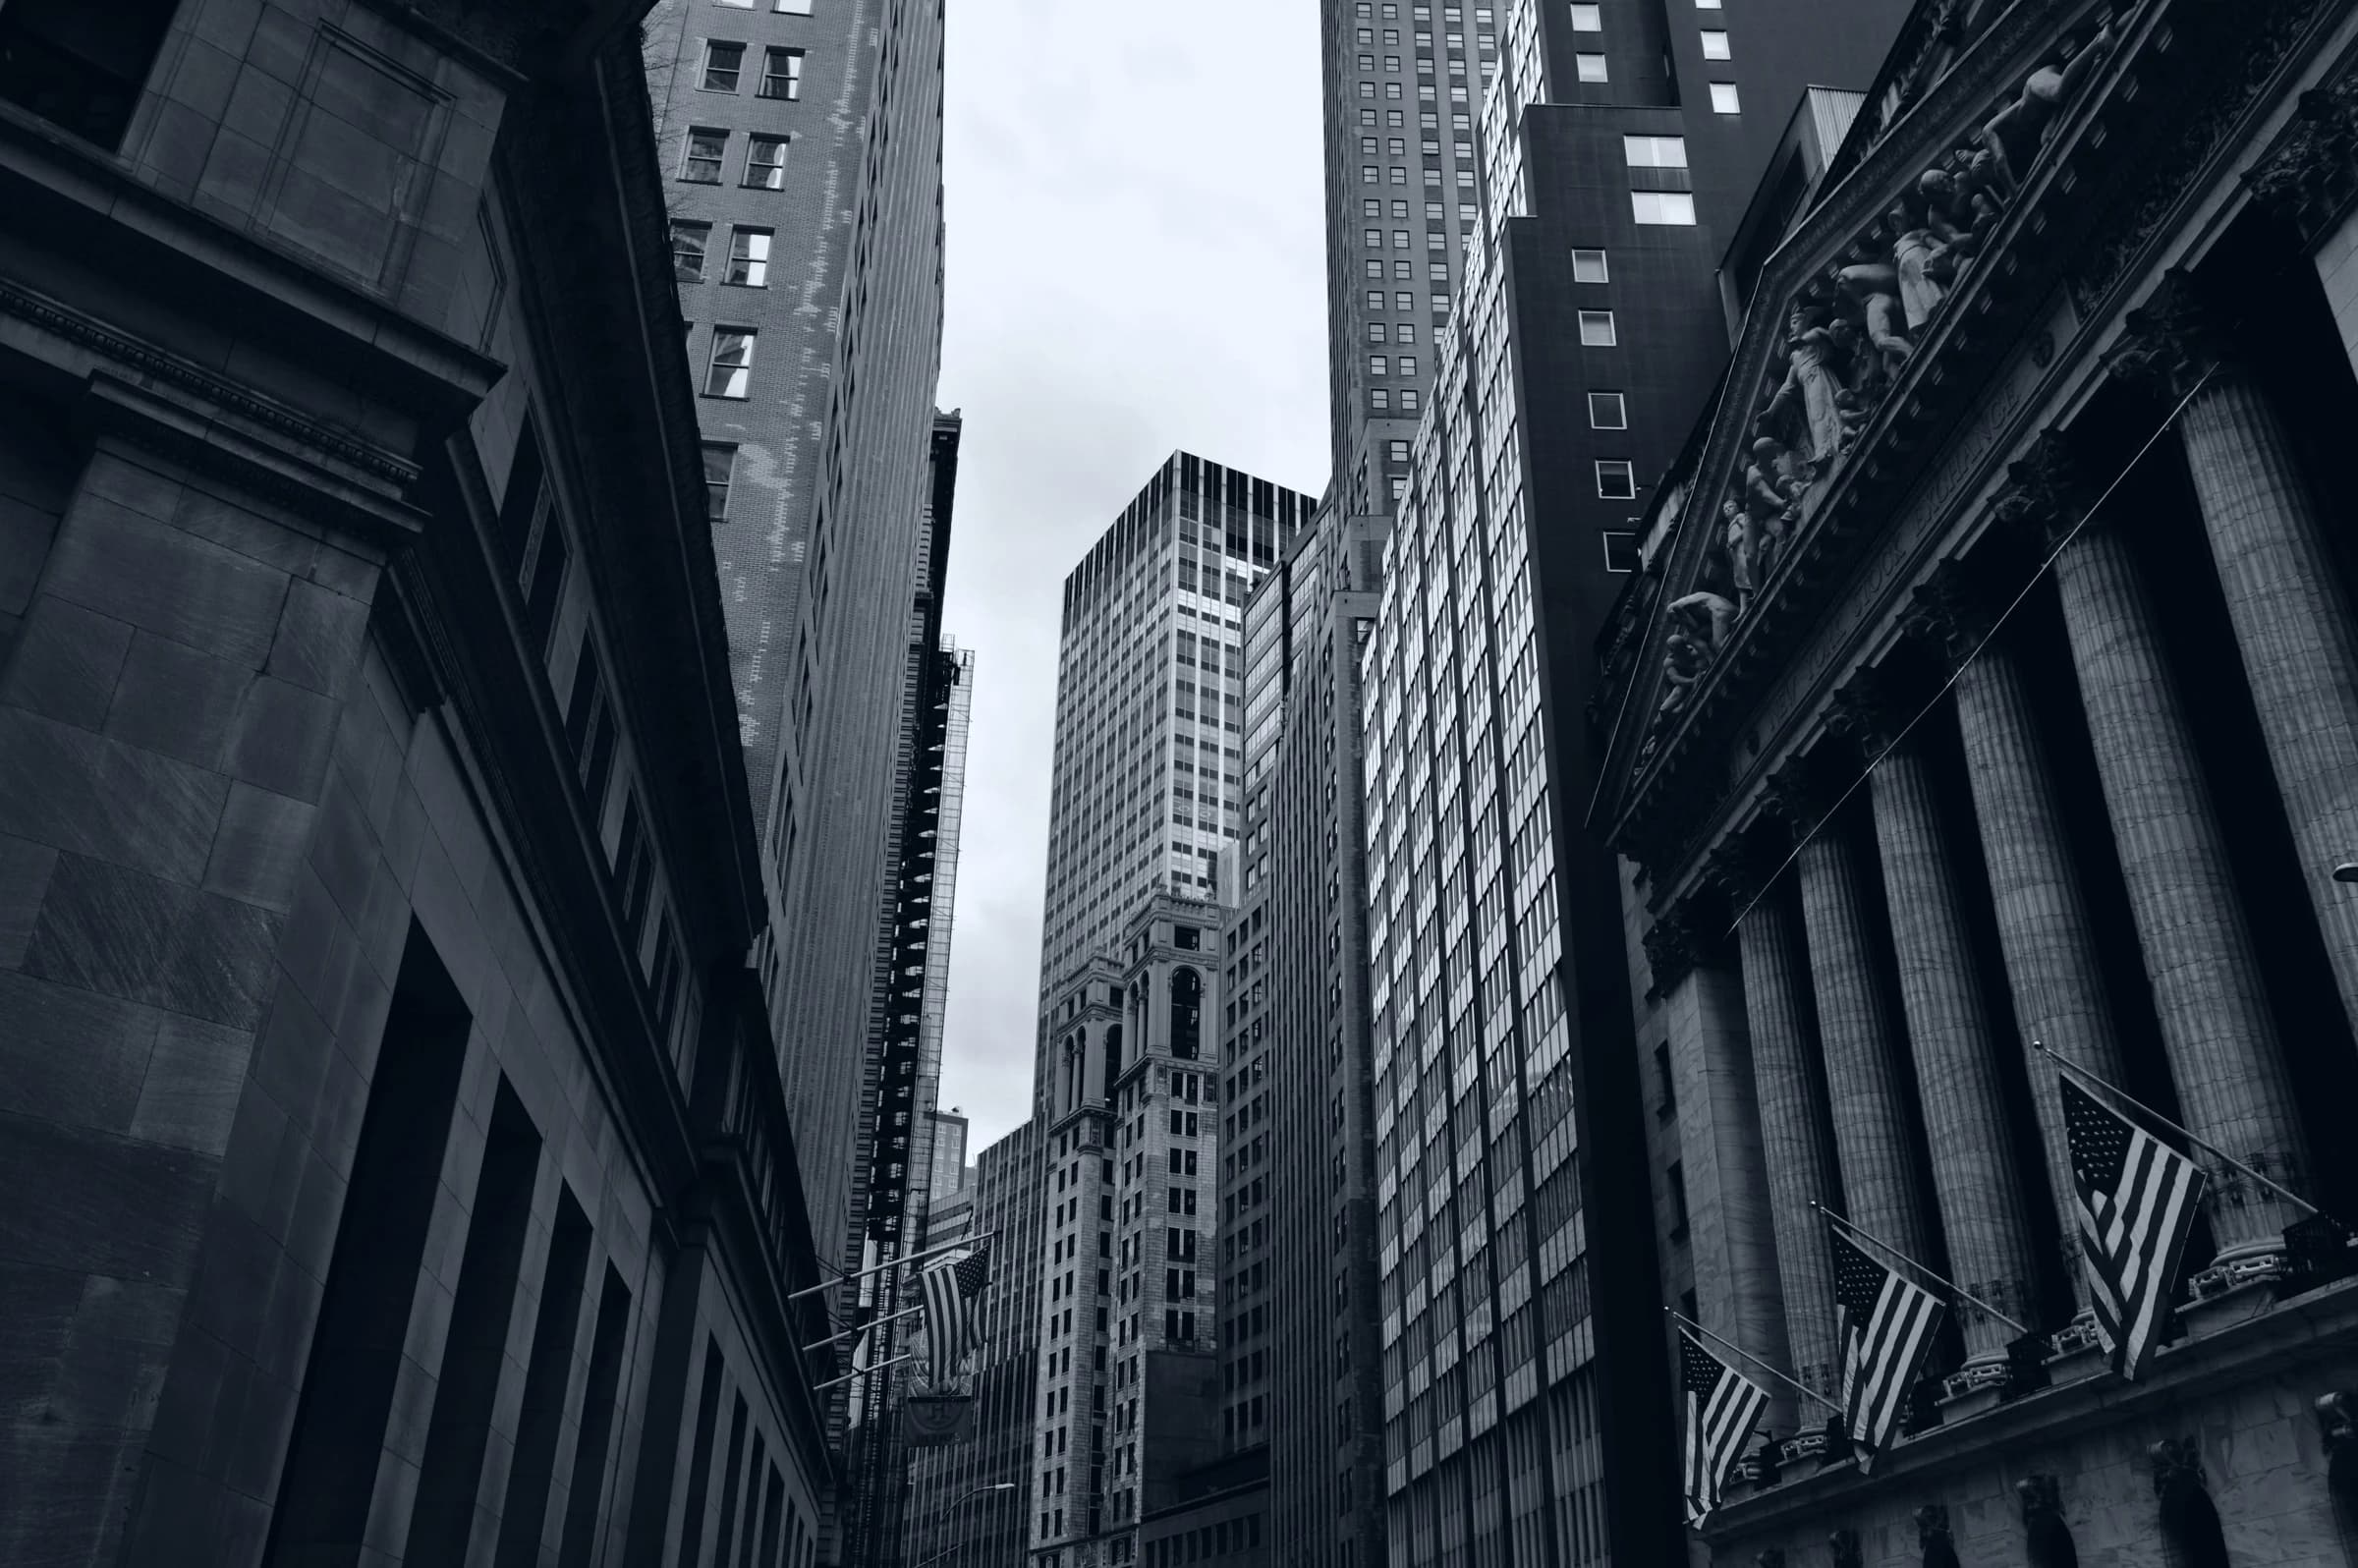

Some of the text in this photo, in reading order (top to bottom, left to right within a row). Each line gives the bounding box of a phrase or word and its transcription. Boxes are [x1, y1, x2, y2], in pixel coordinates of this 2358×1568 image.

[1805, 620, 1847, 681] YORK
[1853, 533, 1907, 618] STOCK
[1913, 378, 2021, 538] EXCHANGE
